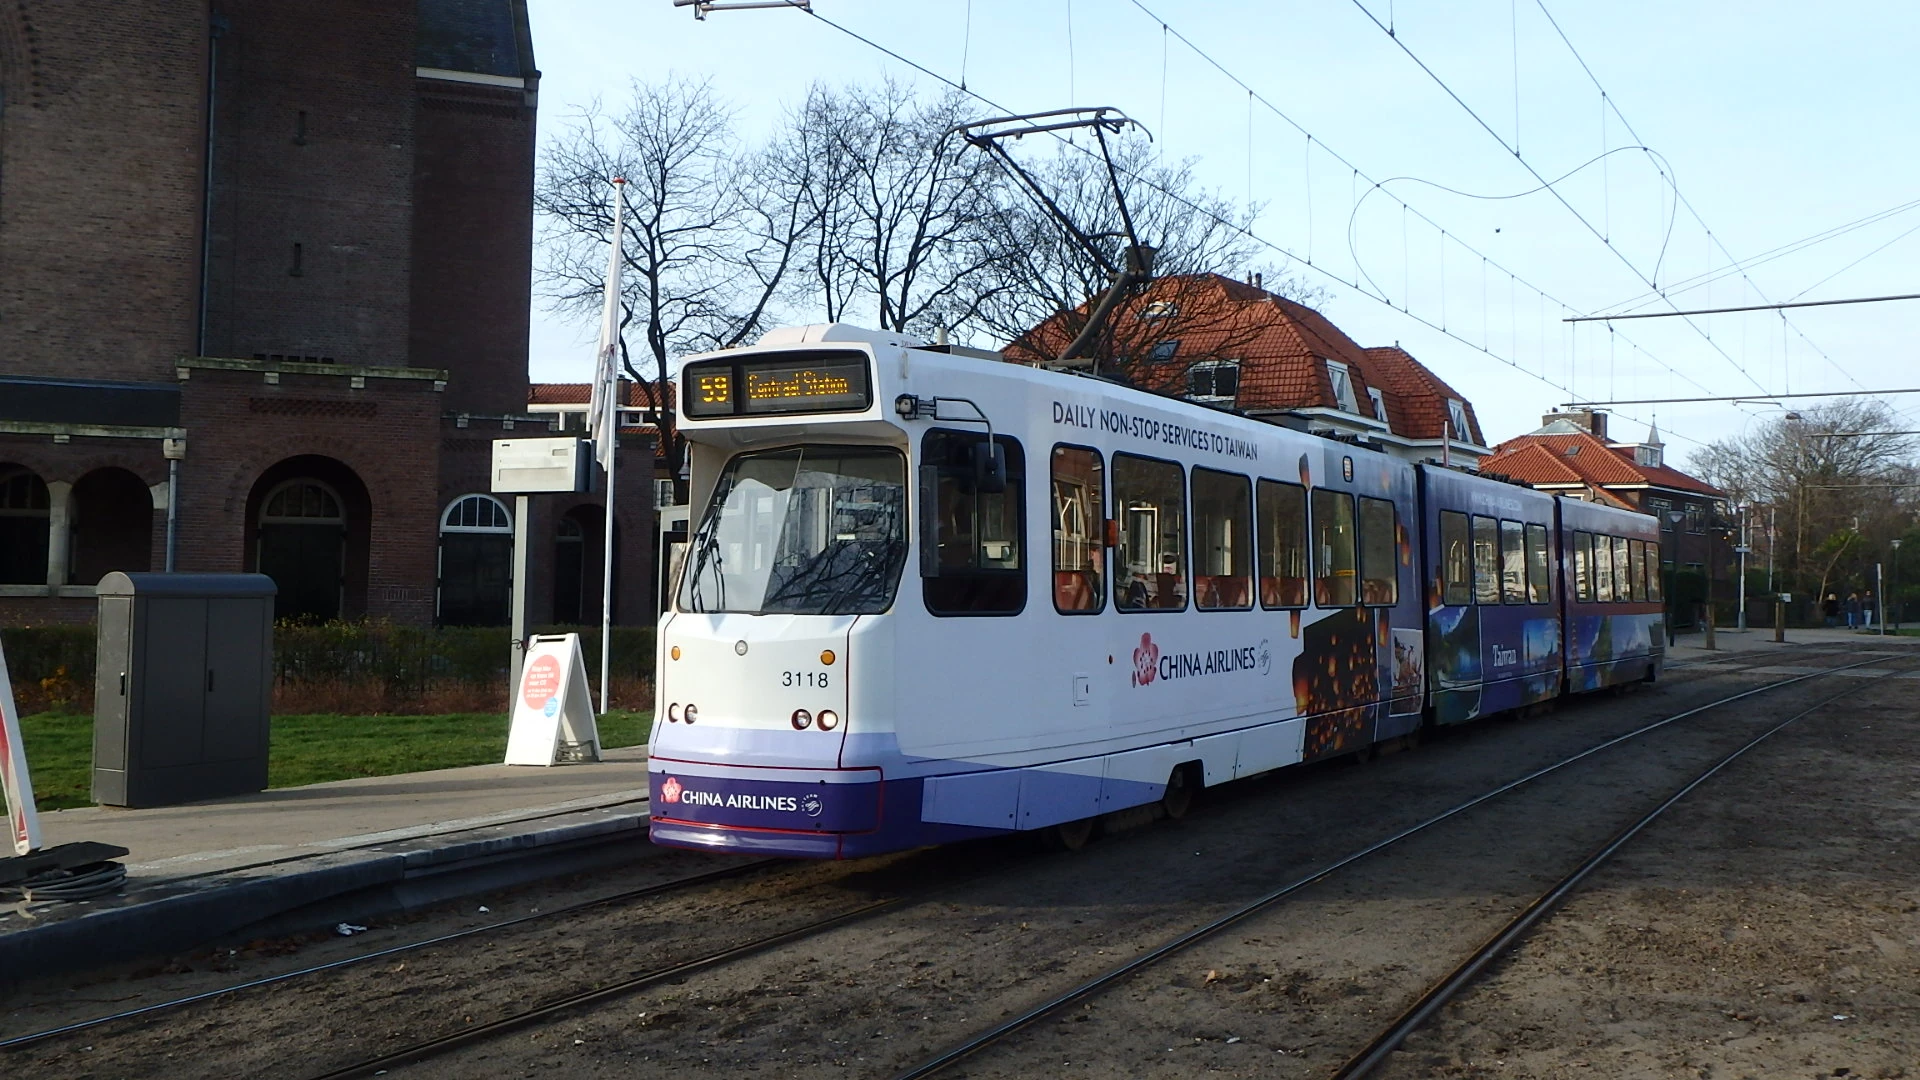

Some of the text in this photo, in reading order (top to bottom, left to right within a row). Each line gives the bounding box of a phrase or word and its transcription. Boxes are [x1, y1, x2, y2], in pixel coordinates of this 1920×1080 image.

[702, 376, 728, 403] 59
[803, 371, 848, 396] Station
[1053, 401, 1258, 461] DAILY NON-STOP SERVICES TO TAIWAN
[1160, 652, 1202, 681] CHINA
[1205, 646, 1256, 675] AIRLINES
[1492, 644, 1517, 667] Taiwan
[782, 671, 829, 688] 3118
[681, 790, 797, 812] CHINA AIRLINES
